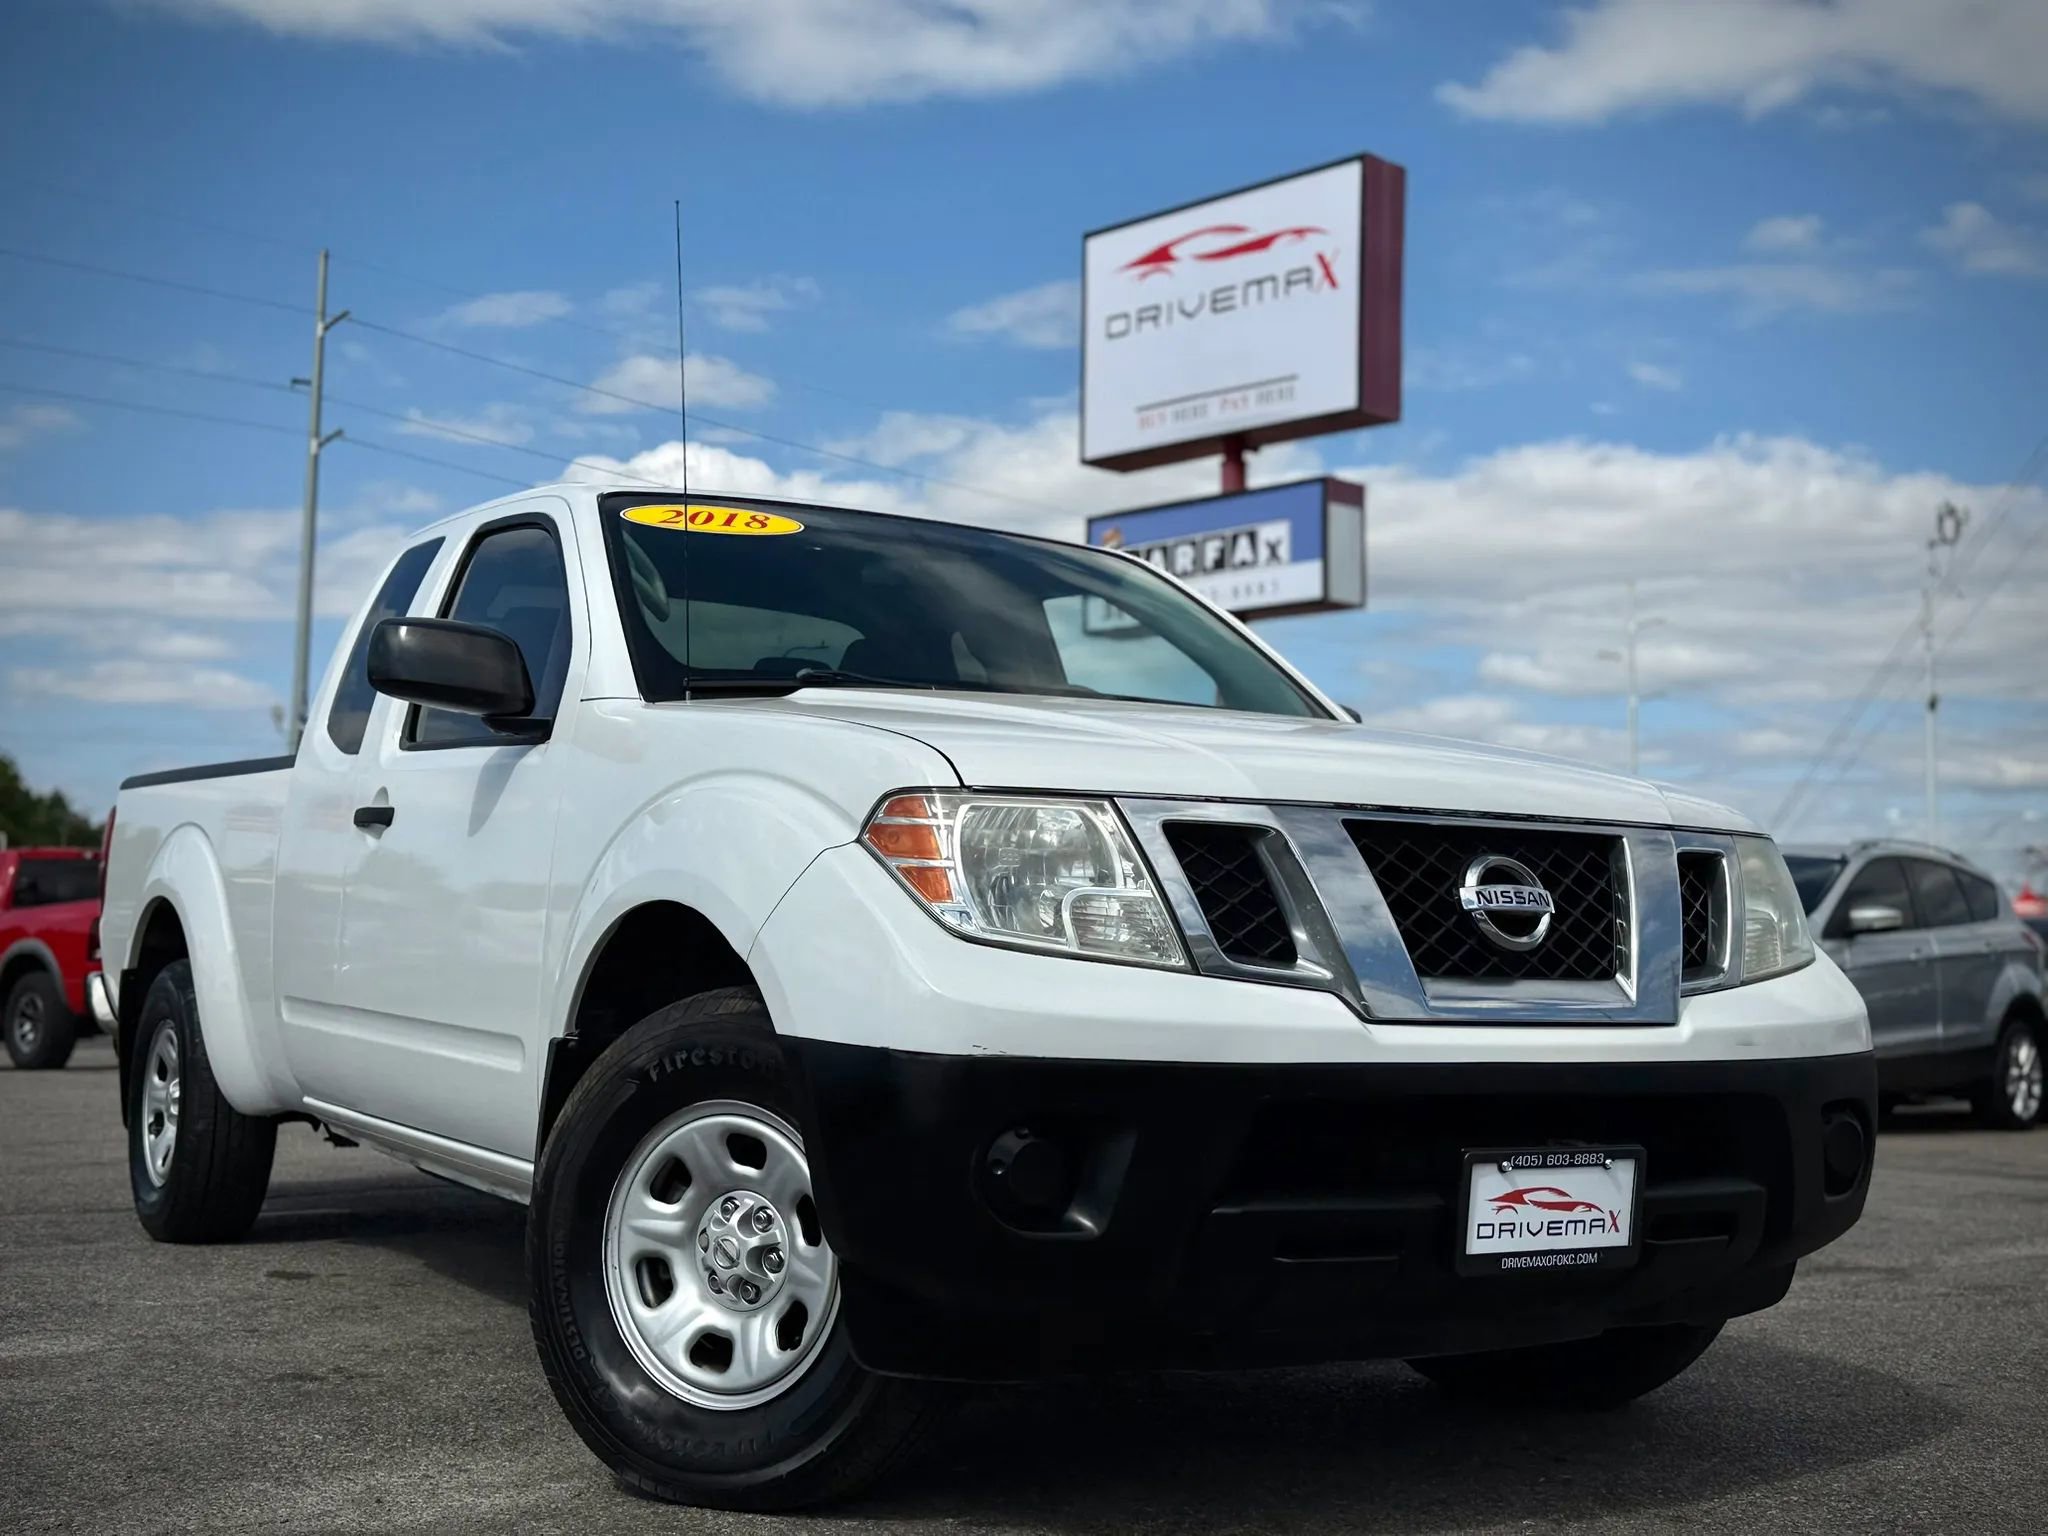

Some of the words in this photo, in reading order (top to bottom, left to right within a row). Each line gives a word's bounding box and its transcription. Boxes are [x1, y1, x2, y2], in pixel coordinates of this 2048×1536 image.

[1105, 248, 1341, 341] DRIVEMAX
[657, 510, 770, 529] 2018
[1126, 527, 1285, 578] ARFAX
[1475, 890, 1550, 907] NISSAN
[1511, 1155, 1543, 1167] (405)
[1547, 1153, 1604, 1166] 603-8883
[1476, 1209, 1621, 1240] DRIVEMAX
[1501, 1253, 1598, 1269] DRIVEMAXOFOKC.COM
